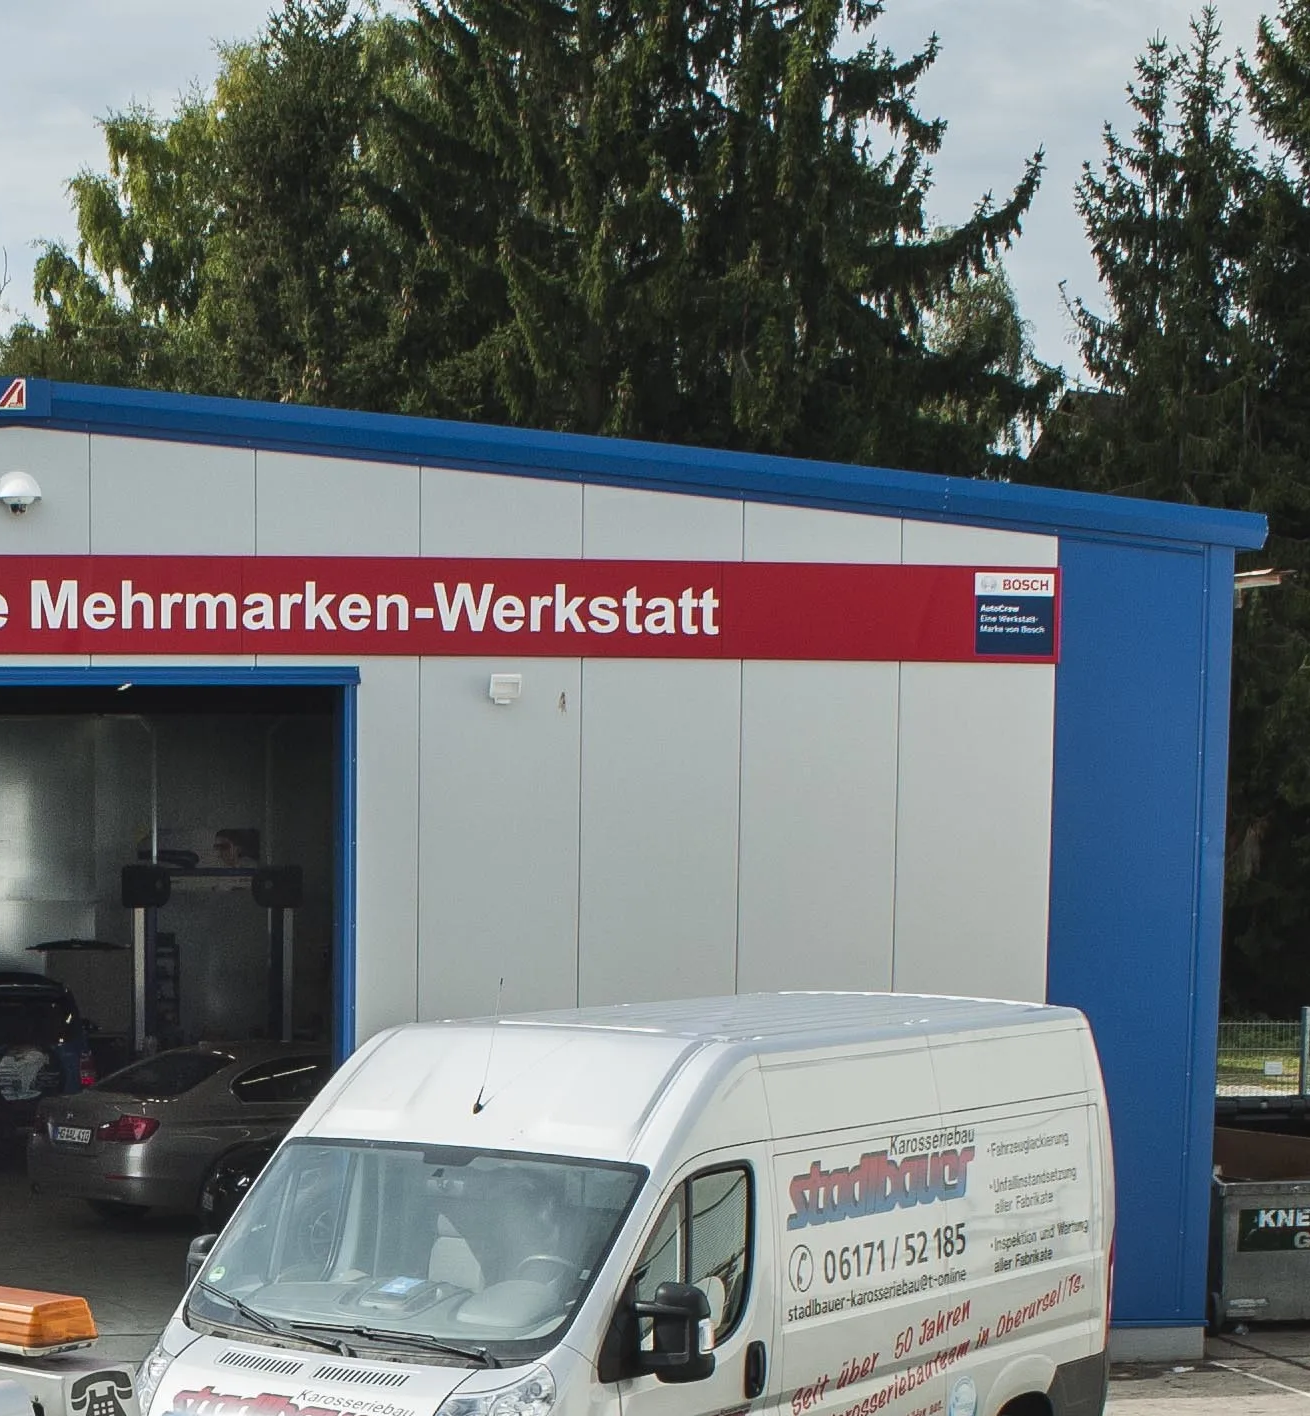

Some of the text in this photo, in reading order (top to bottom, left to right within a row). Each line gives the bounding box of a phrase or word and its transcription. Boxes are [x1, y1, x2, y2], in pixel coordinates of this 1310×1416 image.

[1002, 579, 1049, 591] BOSCH
[31, 580, 720, 635] Mehrmarken-Werkstatt
[890, 1127, 975, 1155] Karosseriebau
[787, 1146, 975, 1231] stadlbauer
[994, 1231, 1037, 1252] Inspektion
[1040, 1224, 1055, 1240] und
[824, 1240, 885, 1284] 06171
[994, 1248, 1053, 1273] aller Fabrikate
[975, 1326, 989, 1351] in
[792, 1300, 971, 1416] Seit über 50 Jahren
